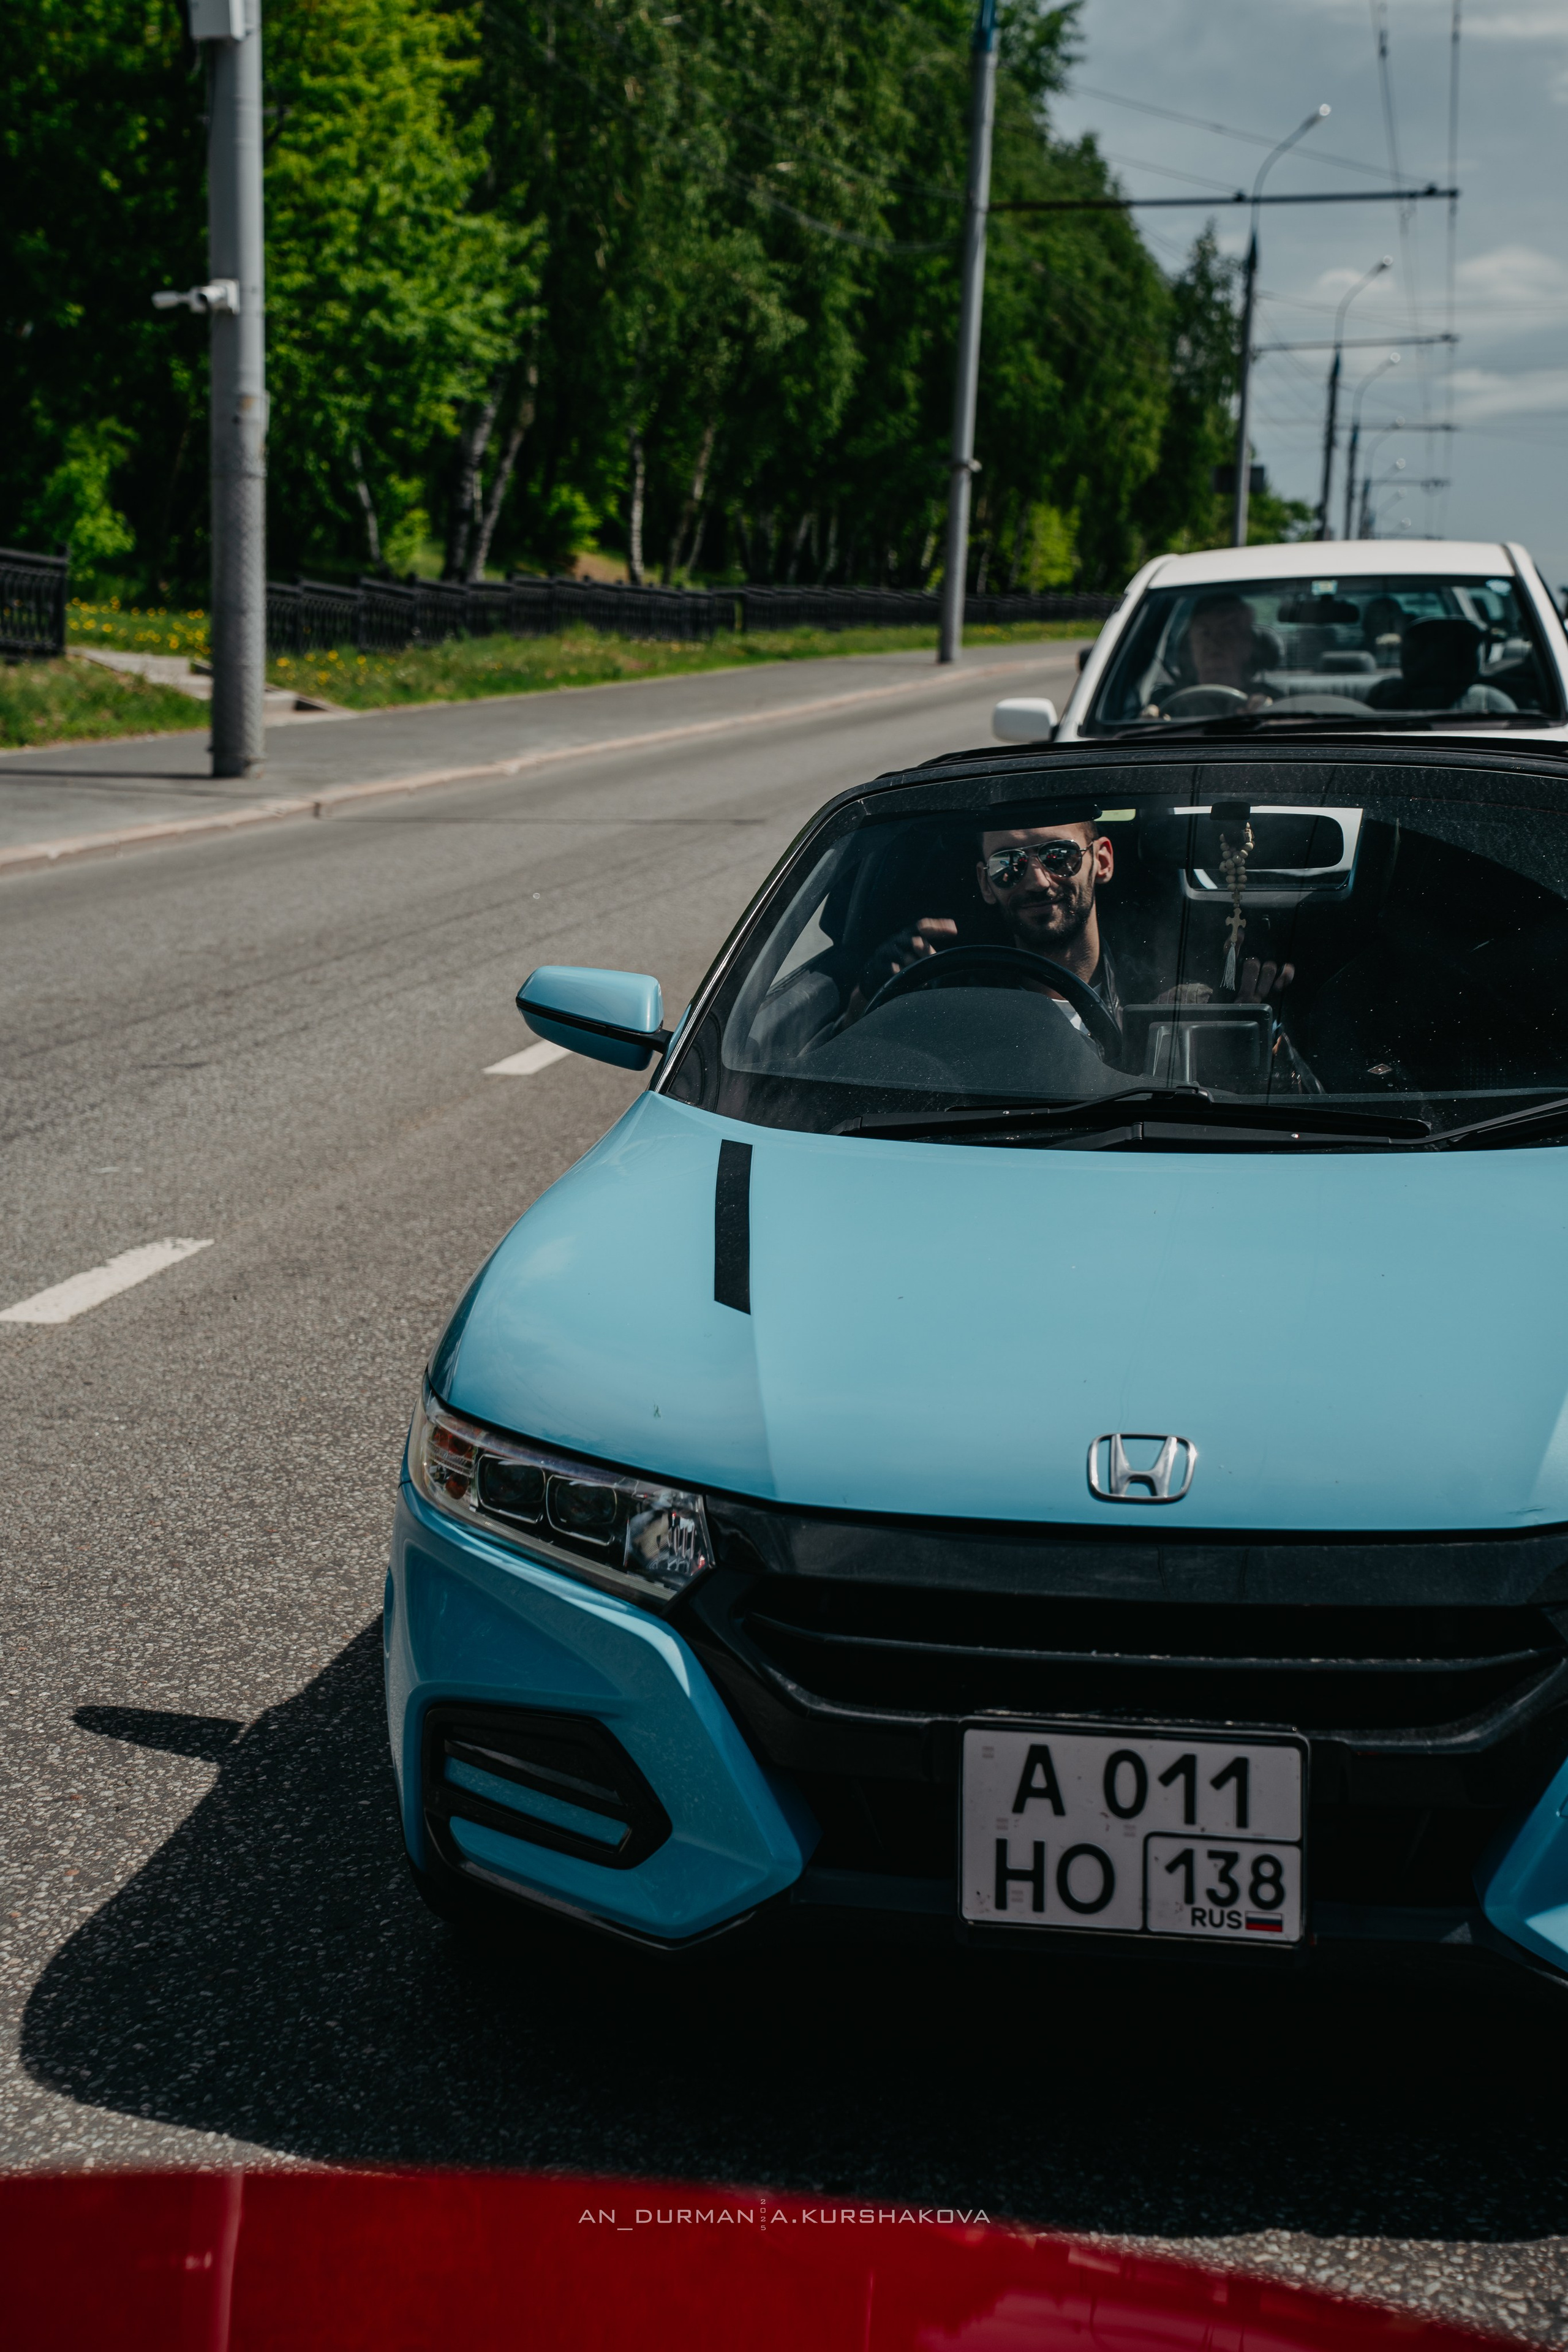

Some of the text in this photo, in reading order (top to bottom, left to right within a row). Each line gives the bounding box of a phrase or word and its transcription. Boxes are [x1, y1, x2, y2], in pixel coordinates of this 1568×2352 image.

[1102, 1748, 1250, 1829] 011
[1164, 1847, 1286, 1911] 138
[1191, 1907, 1243, 1930] RUS
